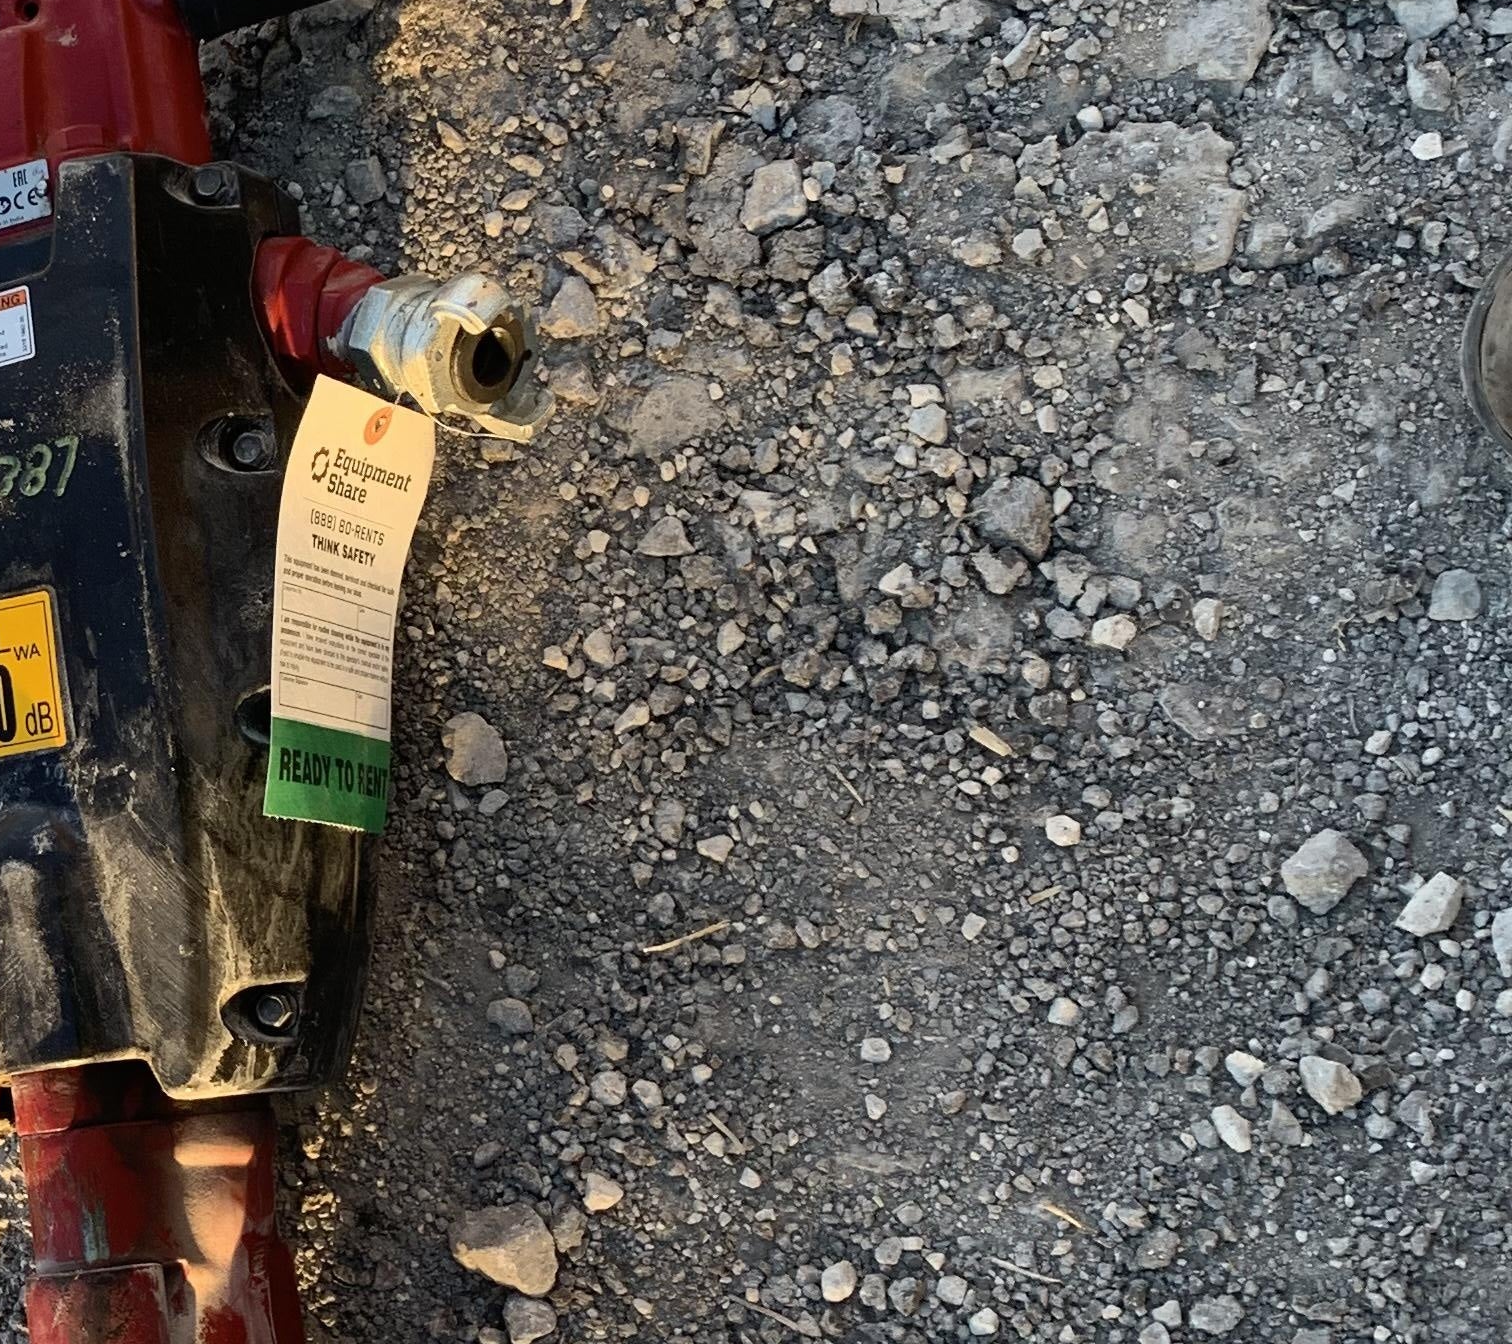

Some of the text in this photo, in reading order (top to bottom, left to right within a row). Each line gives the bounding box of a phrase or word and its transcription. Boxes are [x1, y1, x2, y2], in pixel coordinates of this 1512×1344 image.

[327, 473, 367, 504] Share
[333, 447, 412, 493] Equipment
[310, 508, 385, 547] (888) 80-RENTS
[312, 534, 376, 568] THINK SAFETY
[25, 701, 54, 736] dB
[279, 747, 388, 800] READY TO RENT
